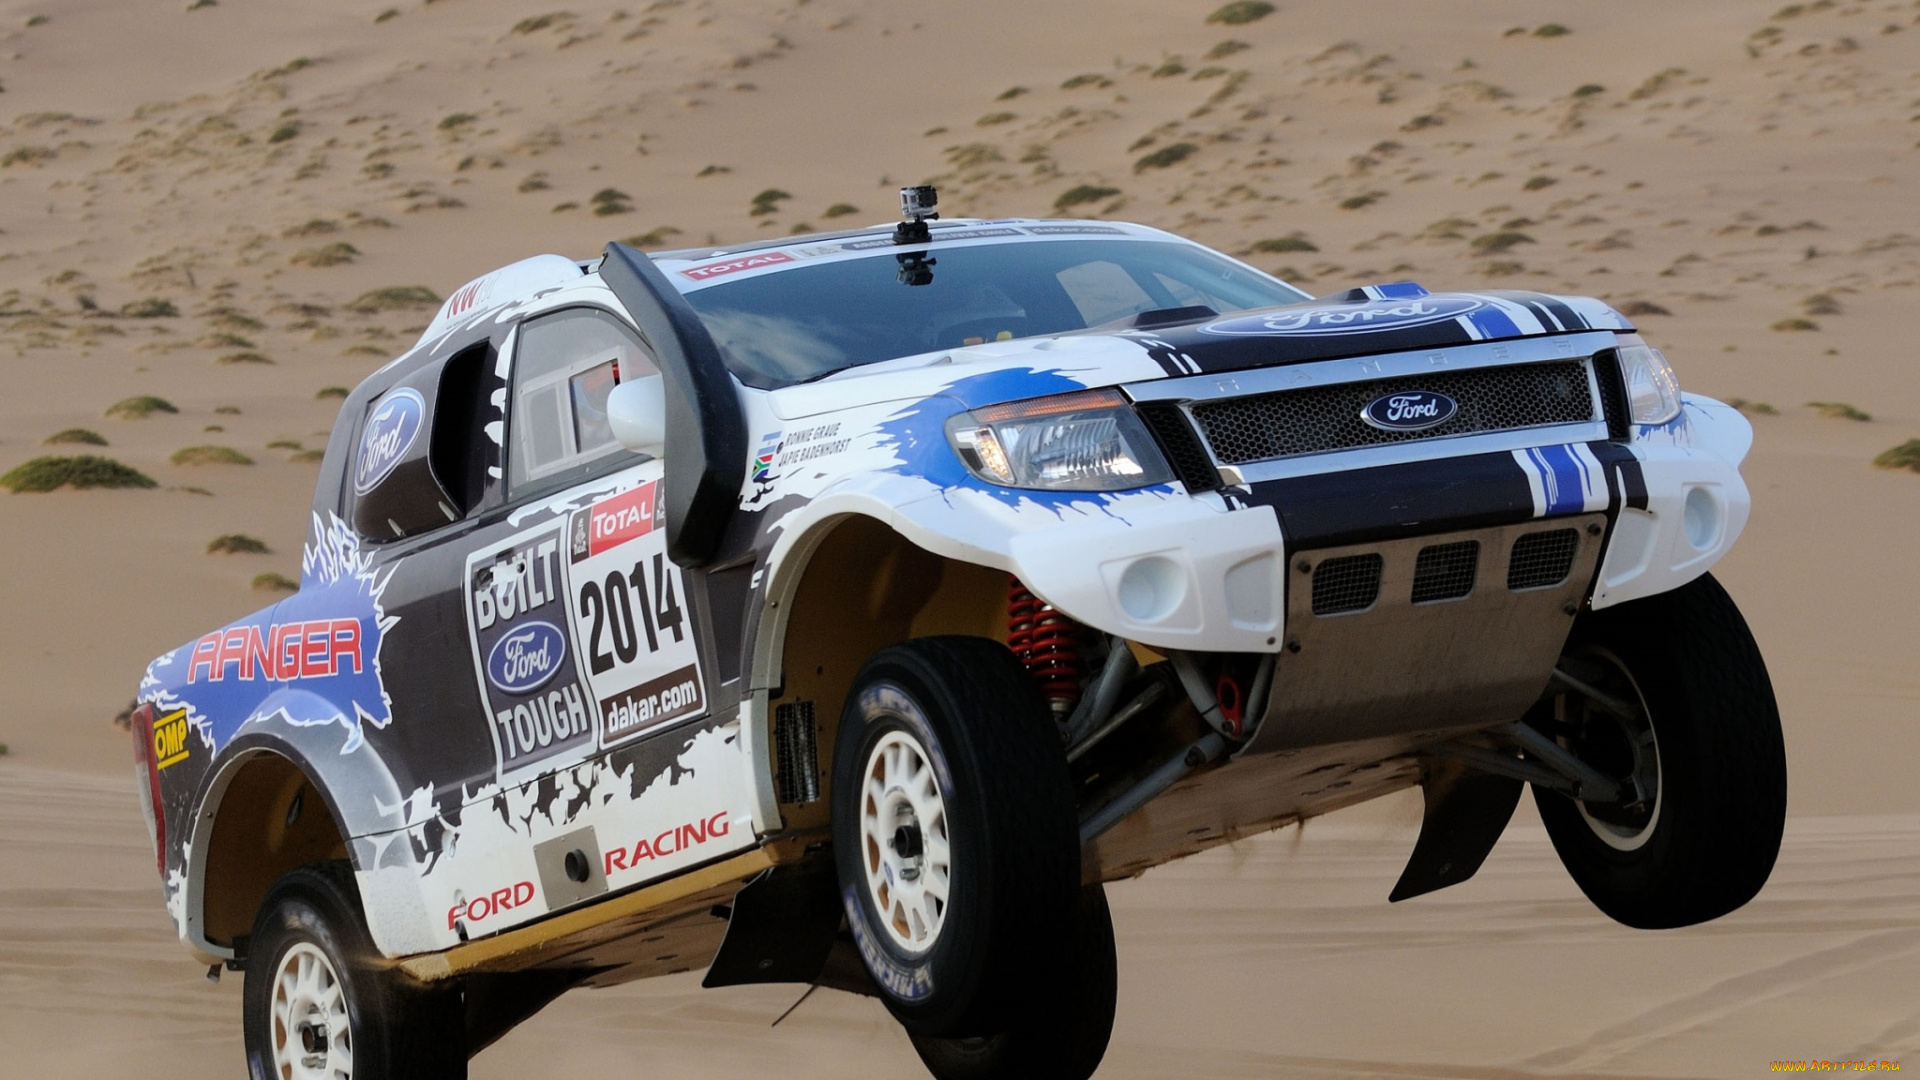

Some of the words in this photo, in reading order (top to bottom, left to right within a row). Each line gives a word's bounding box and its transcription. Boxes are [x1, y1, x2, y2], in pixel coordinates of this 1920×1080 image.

[689, 256, 786, 276] TOTAL
[1263, 302, 1439, 330] Ford
[1386, 394, 1439, 421] Ford
[360, 404, 406, 473] Ford
[778, 449, 801, 468] JAPIE
[799, 438, 852, 460] BADENHORST
[784, 428, 814, 447] RONNIE
[593, 502, 652, 539] TOTAL
[475, 537, 558, 630] BUILT
[580, 552, 684, 676] 2014
[187, 617, 363, 685] RANGER
[503, 630, 551, 684] Ford
[497, 683, 588, 760] TOUGH
[607, 679, 697, 733] dakar.com
[154, 721, 188, 760] OMP
[447, 880, 536, 931] FORD
[604, 810, 730, 876] RACING
